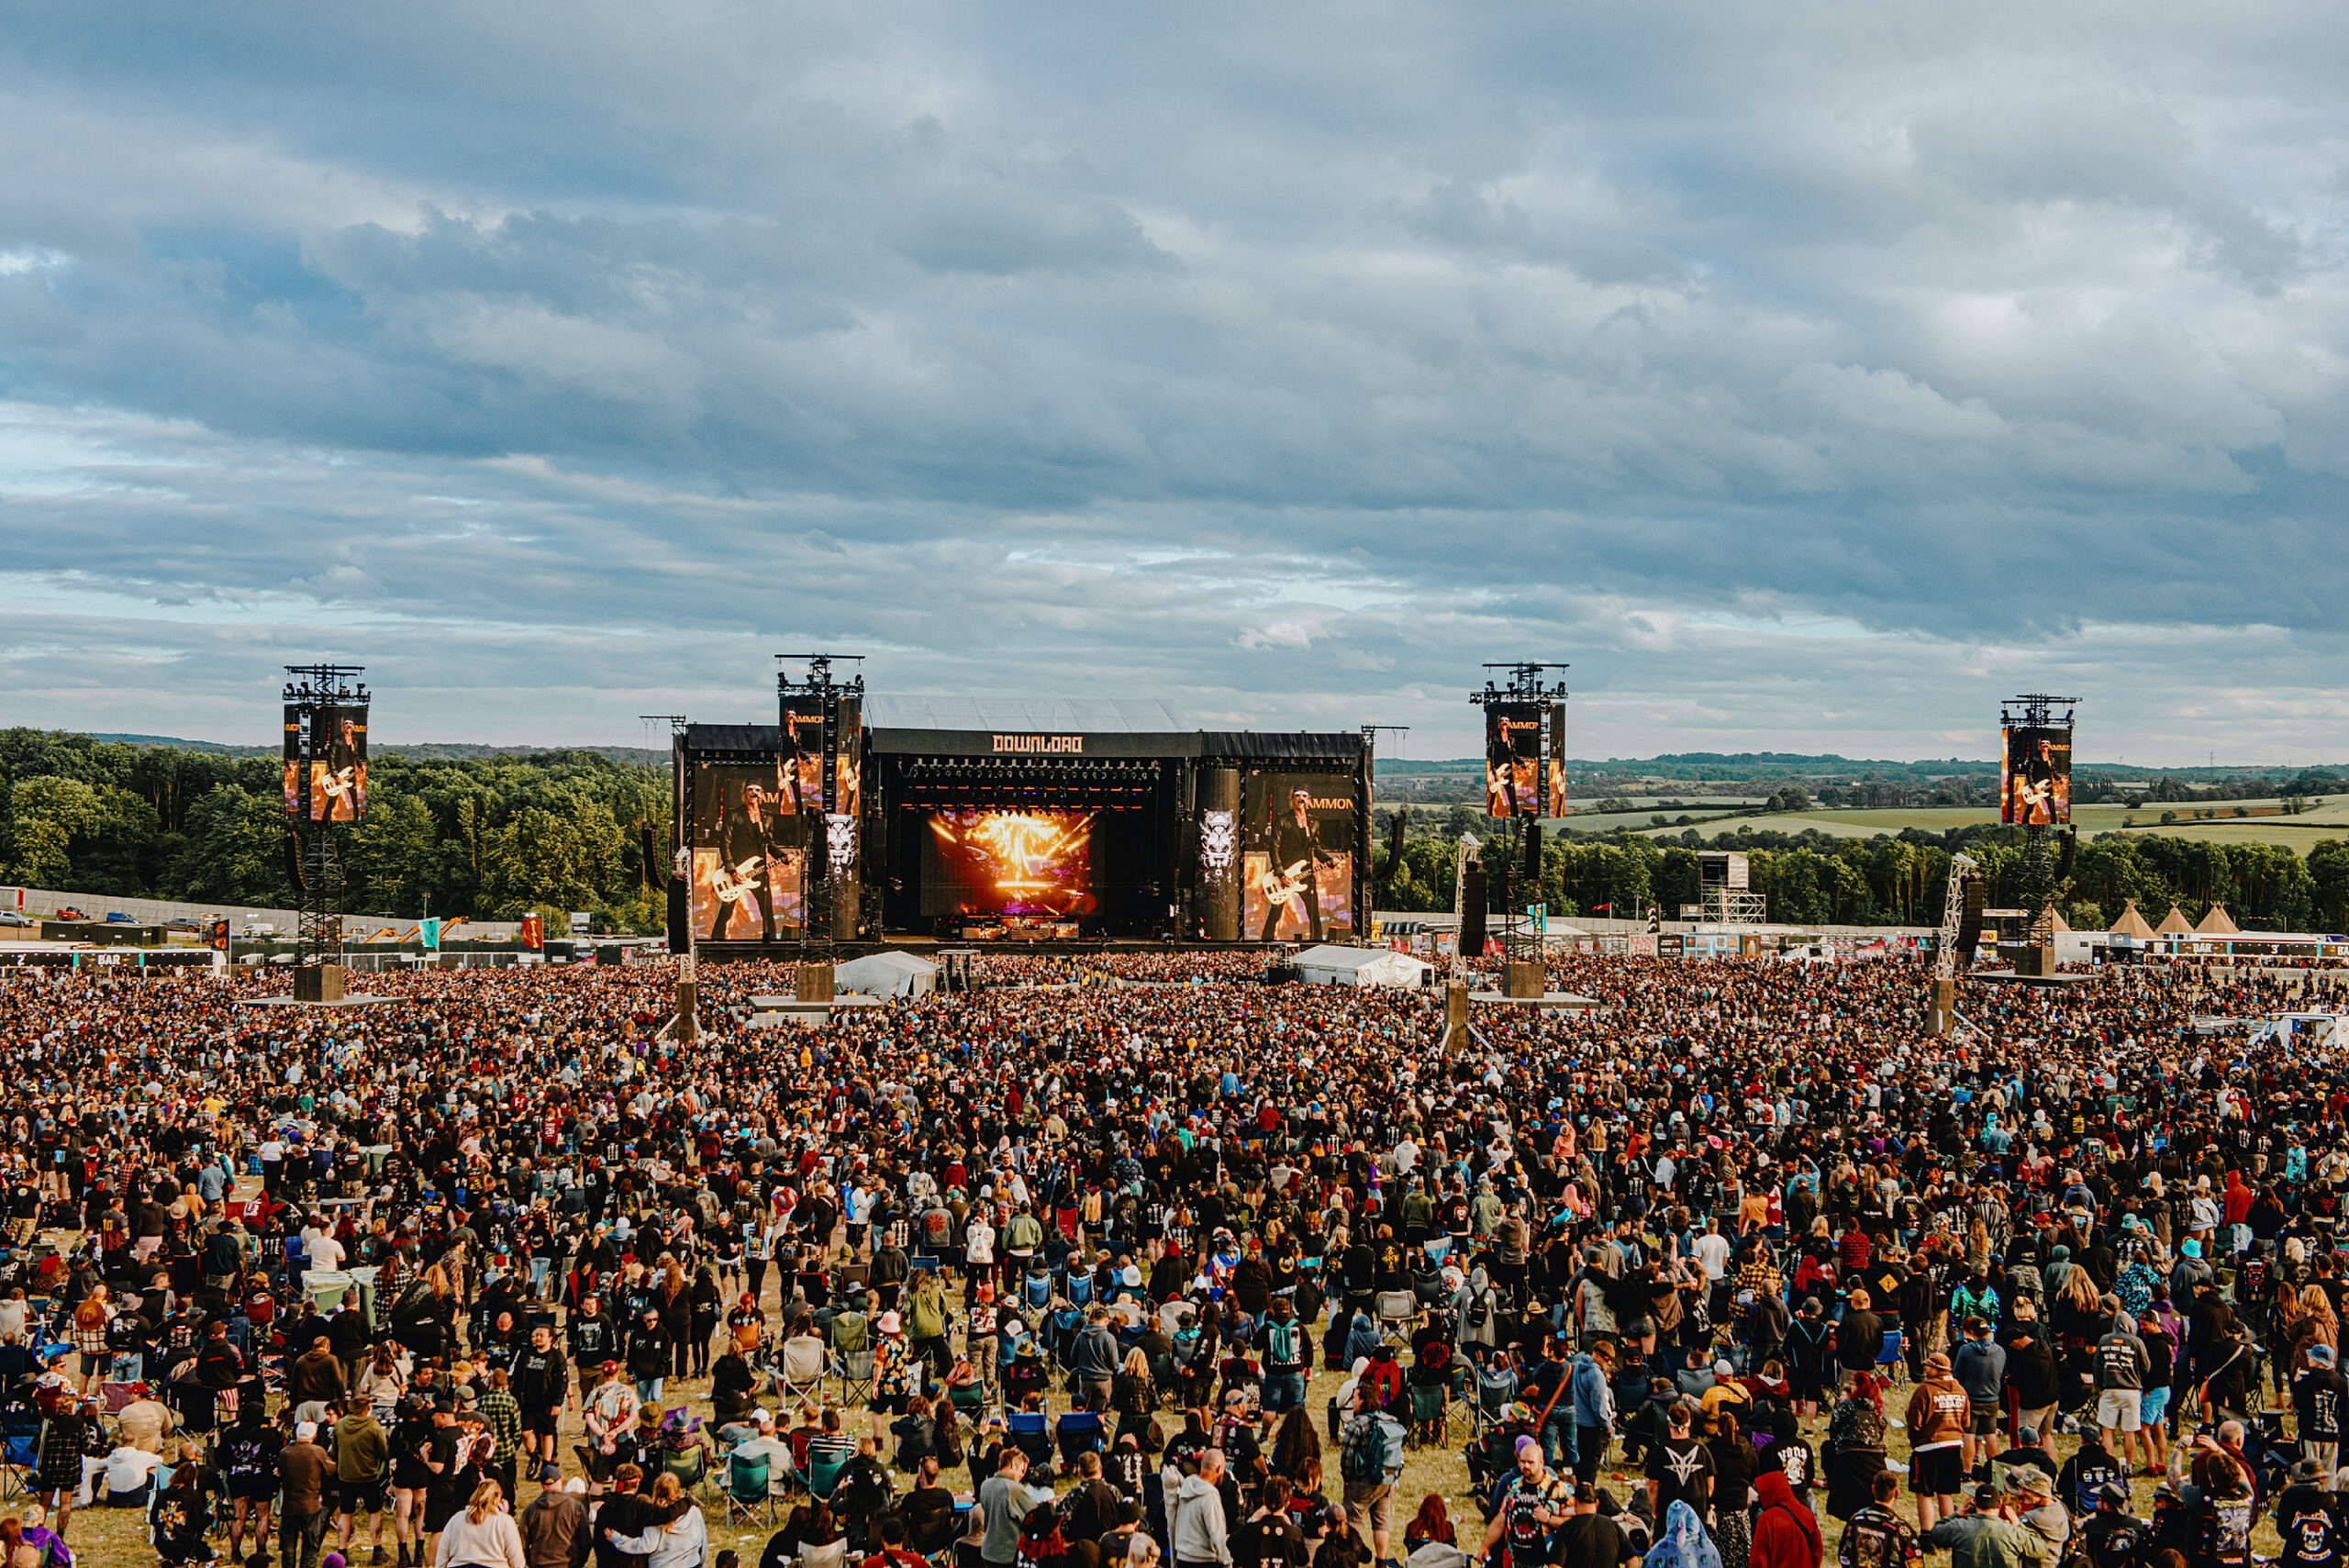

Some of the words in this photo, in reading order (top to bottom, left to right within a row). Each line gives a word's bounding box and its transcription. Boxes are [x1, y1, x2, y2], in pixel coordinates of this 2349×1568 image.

[992, 735, 1084, 753] DOWNLOAD
[2193, 942, 2212, 953] BAR
[2271, 944, 2279, 954] 3
[97, 954, 121, 965] BAR
